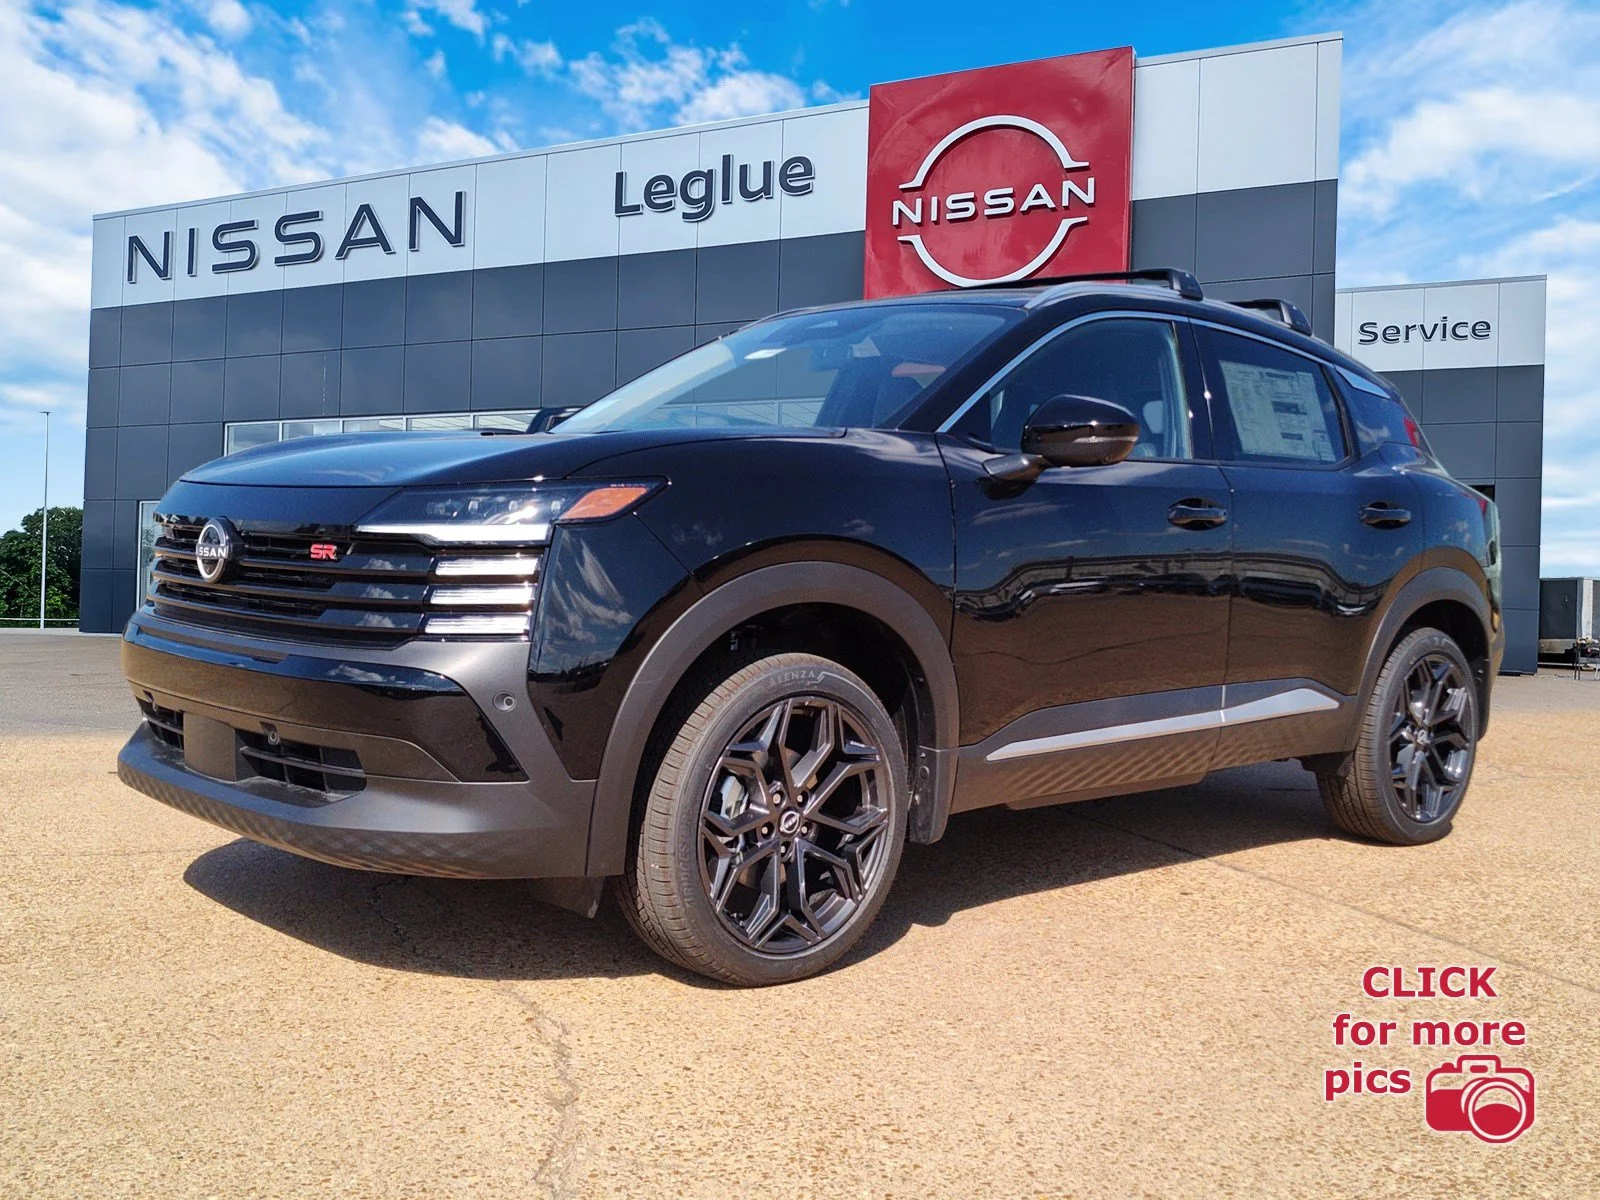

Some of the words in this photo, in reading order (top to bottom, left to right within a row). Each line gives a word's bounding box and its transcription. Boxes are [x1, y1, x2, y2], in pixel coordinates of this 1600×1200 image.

[614, 153, 815, 222] Leglue
[892, 177, 1096, 227] NISSAN
[127, 190, 466, 285] NISSAN
[1358, 316, 1492, 345] Service
[197, 545, 228, 558] SSAN
[310, 543, 337, 560] SR
